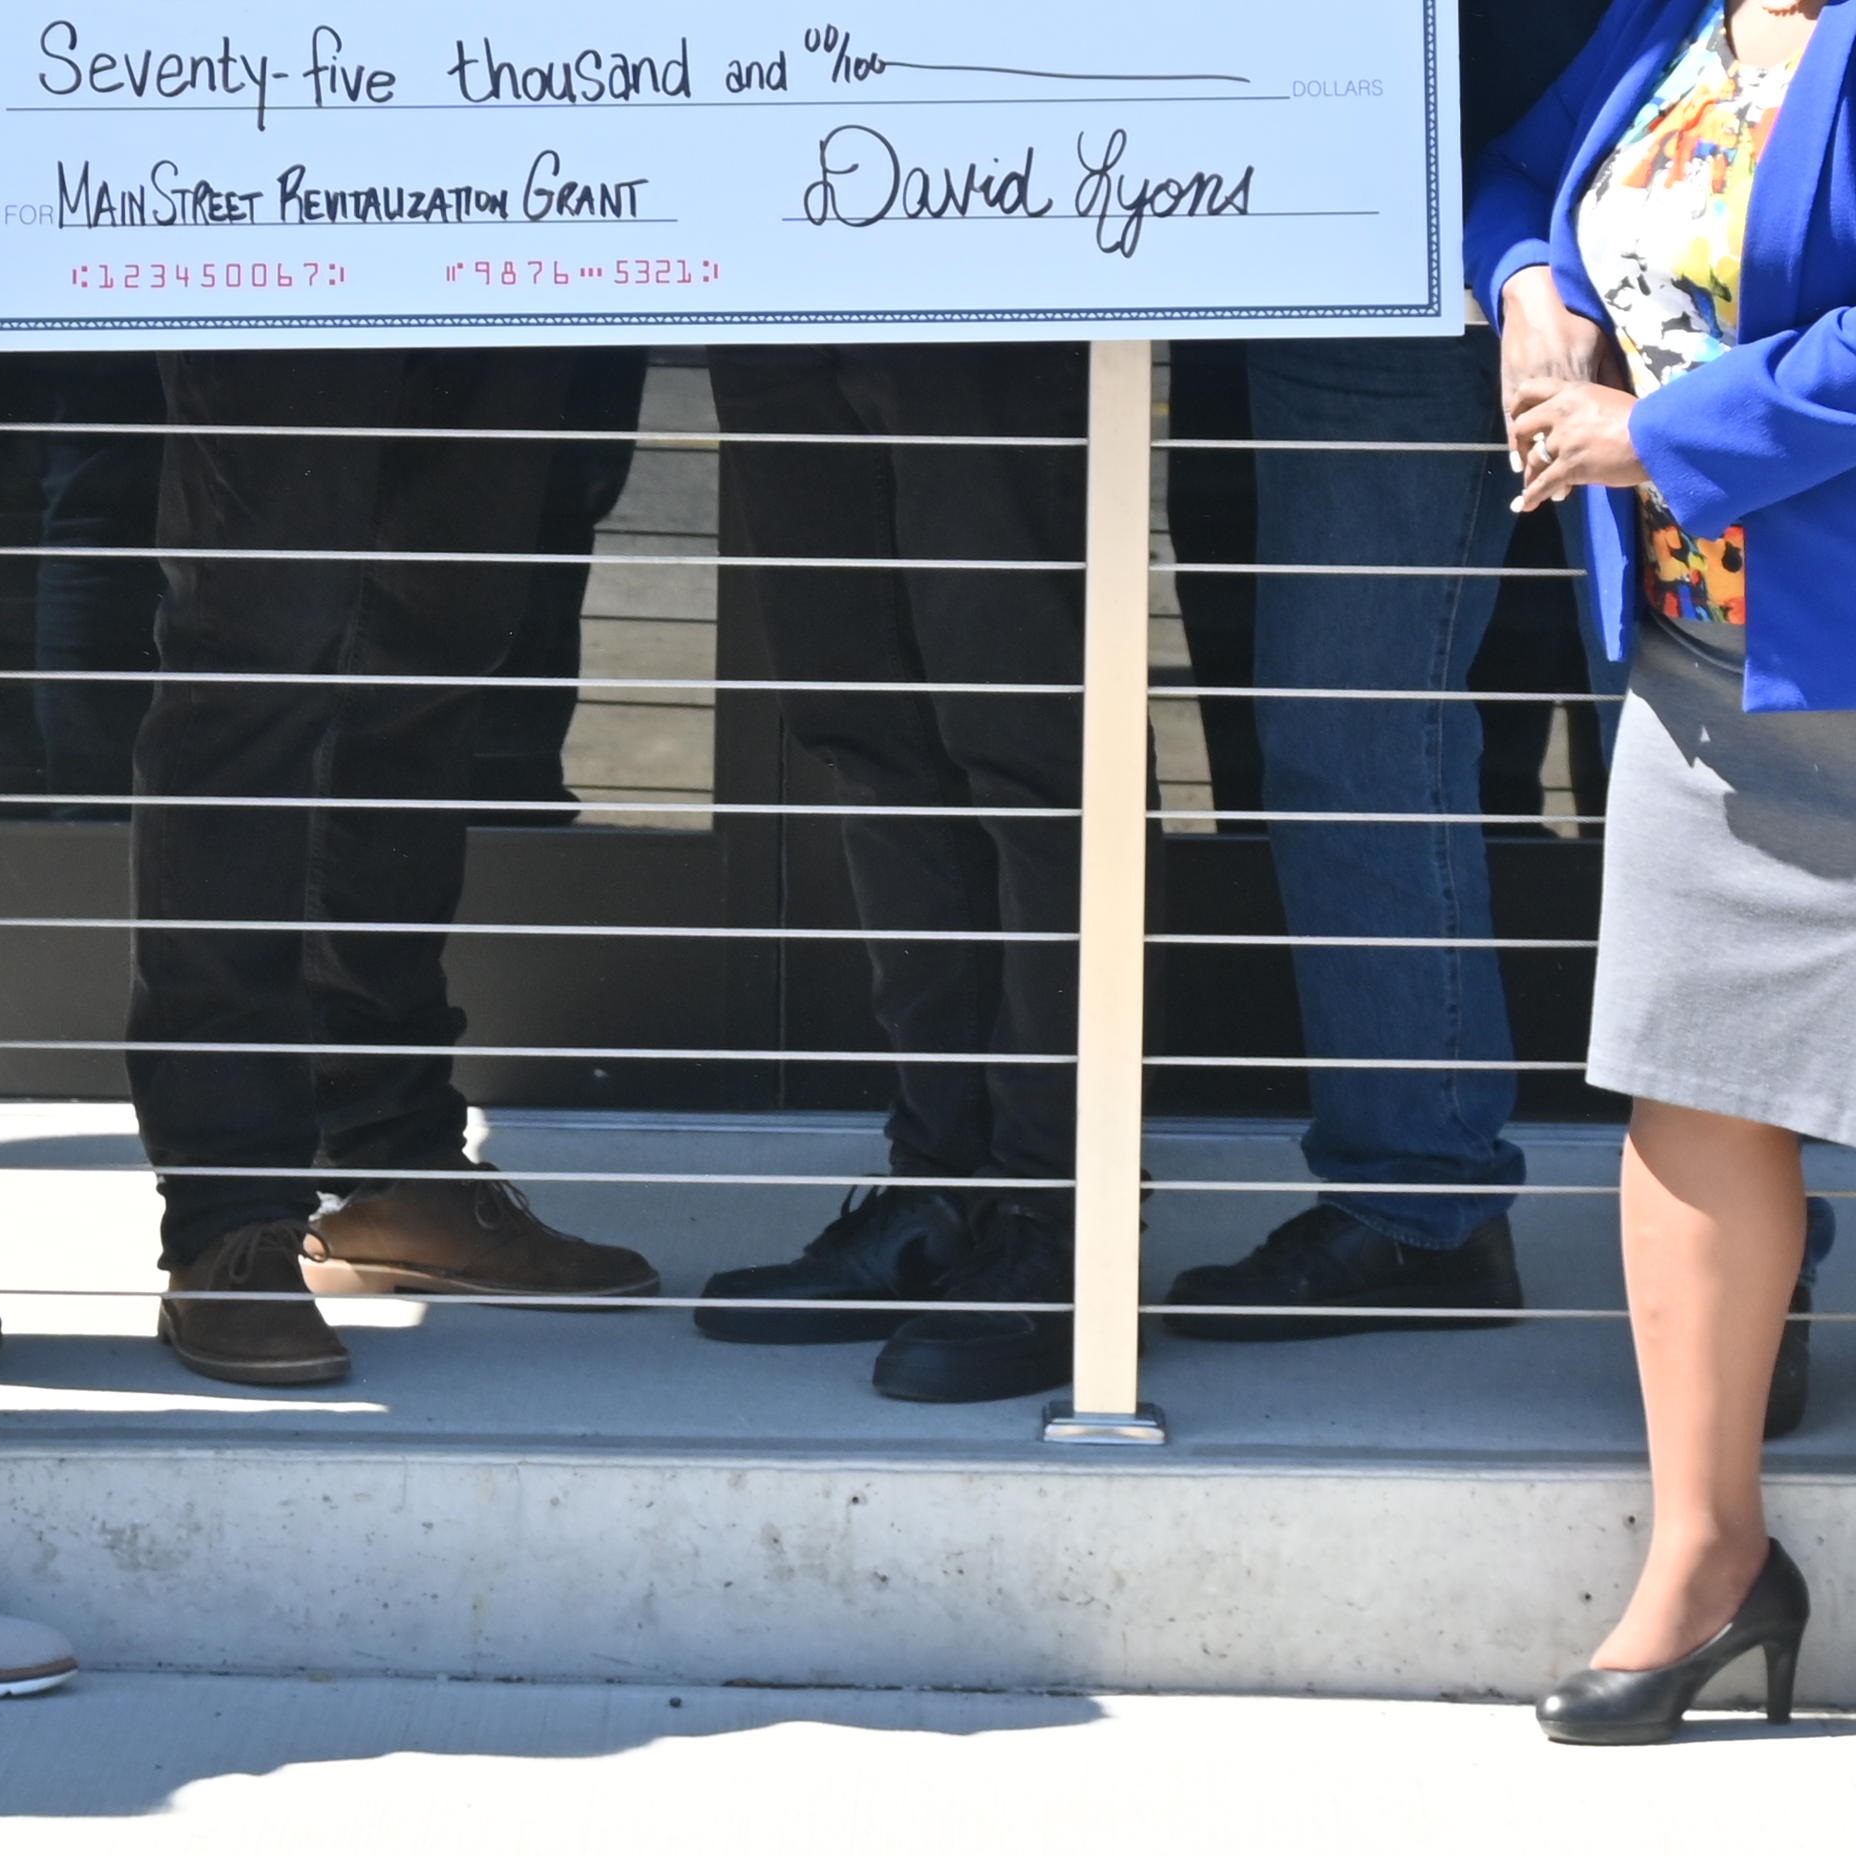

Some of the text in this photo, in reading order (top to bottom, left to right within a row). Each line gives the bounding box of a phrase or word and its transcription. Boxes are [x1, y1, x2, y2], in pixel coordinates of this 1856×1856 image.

[39, 20, 396, 131] Seventy-five
[447, 37, 691, 105] thousand
[726, 50, 787, 93] and
[1292, 79, 1384, 100] DOLLARS
[4, 204, 53, 225] FOR
[523, 150, 649, 222] GRANT
[804, 125, 1254, 258] David Lyons
